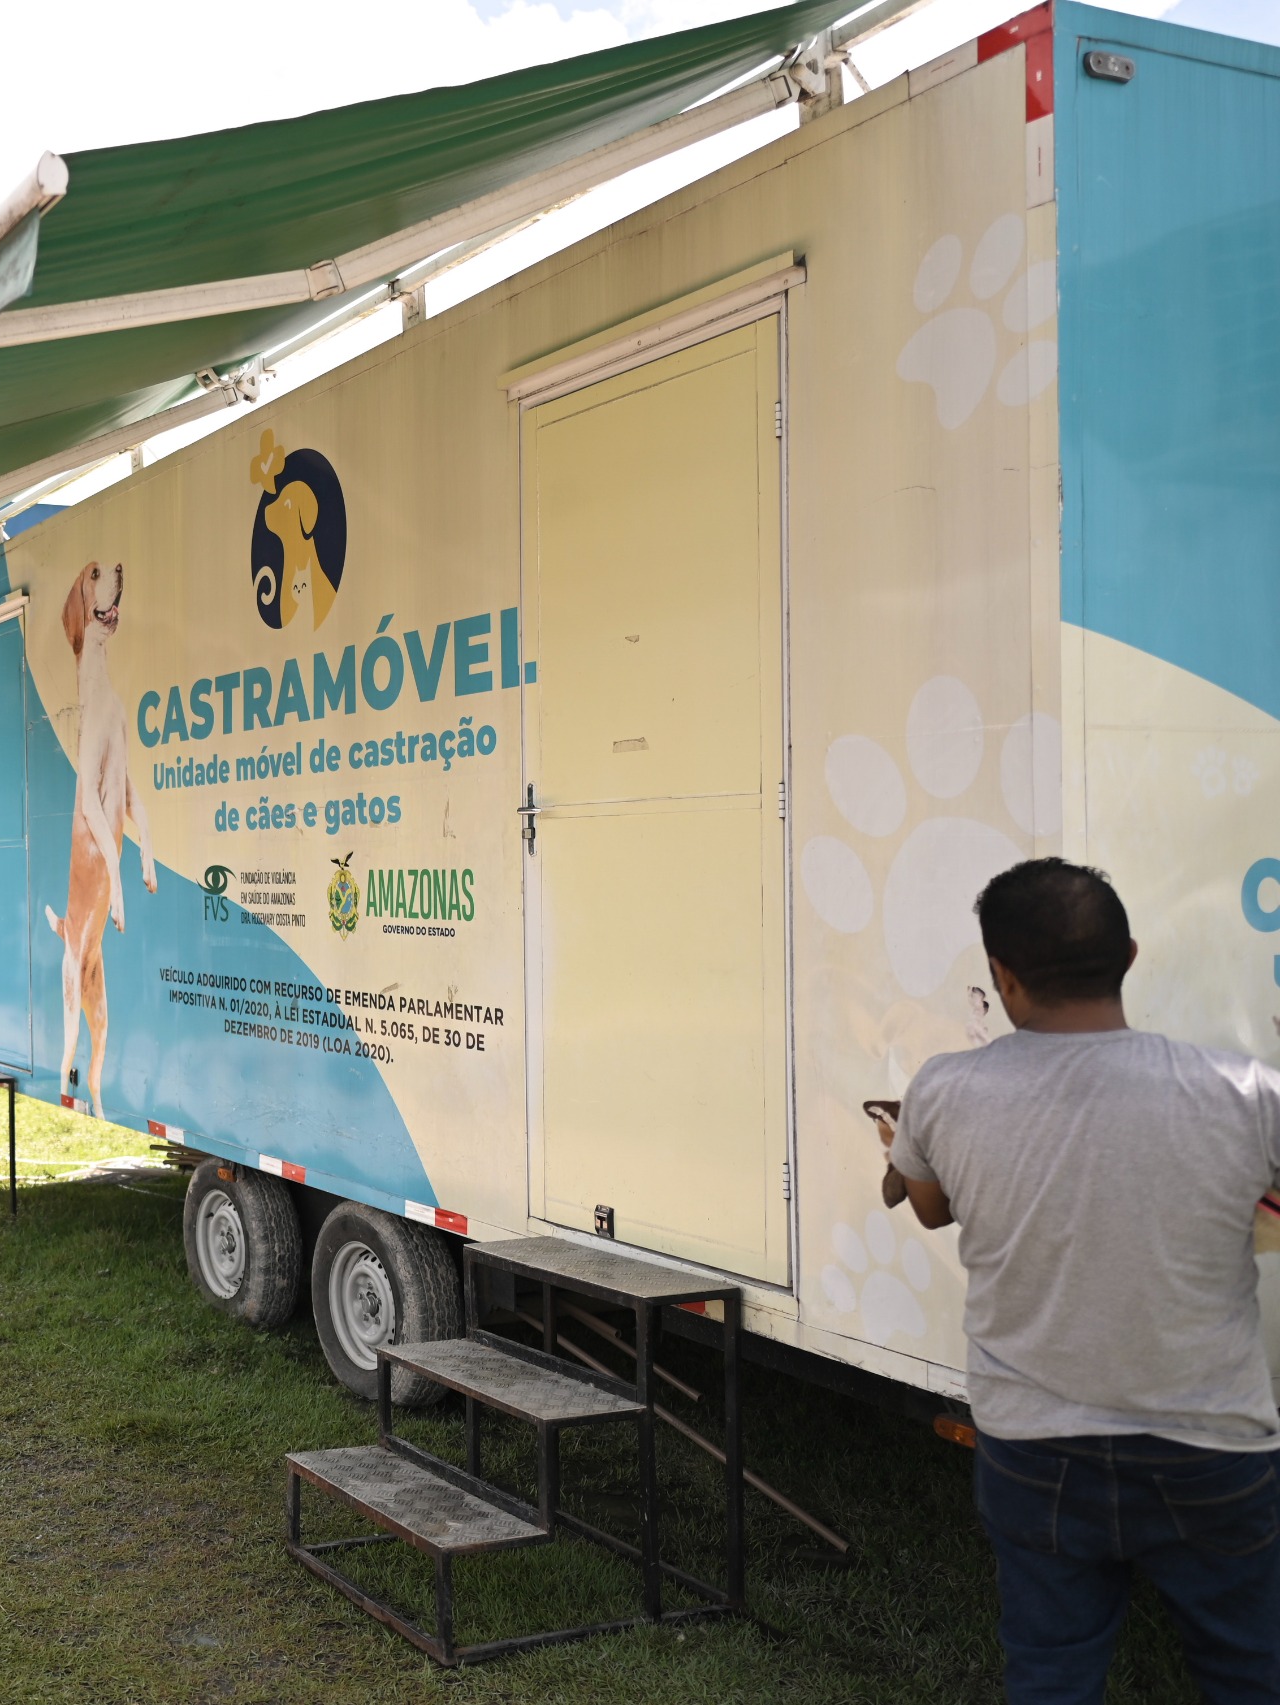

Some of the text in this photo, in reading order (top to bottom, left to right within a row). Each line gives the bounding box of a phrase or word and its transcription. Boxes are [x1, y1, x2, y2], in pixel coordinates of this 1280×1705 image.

[137, 606, 537, 748] CASTRAMÓVEL
[153, 716, 496, 790] Unidade móvel de castração
[214, 793, 401, 835] de cães e gatos
[263, 893, 269, 904] DO
[271, 893, 296, 905] AMAZONAS
[264, 872, 270, 884] DE
[366, 869, 474, 922] AMAZONAS
[204, 896, 229, 922] FVS
[276, 914, 290, 926] COSTA
[292, 914, 306, 927] PINTO
[383, 925, 455, 938] GOVERNO DO ESTADO
[160, 966, 504, 1026] VEÍCULO ADQUIRIDO COM RECURSO DE EMENDA PARLAMENTAR
[170, 990, 484, 1052] IMPOSITIVA N. 01/2020, À LEI ESTADUAL N. 5.065, DE 30 DE
[224, 1019, 393, 1063] DEZEMBRO DE 2019 (LOA 2020).
